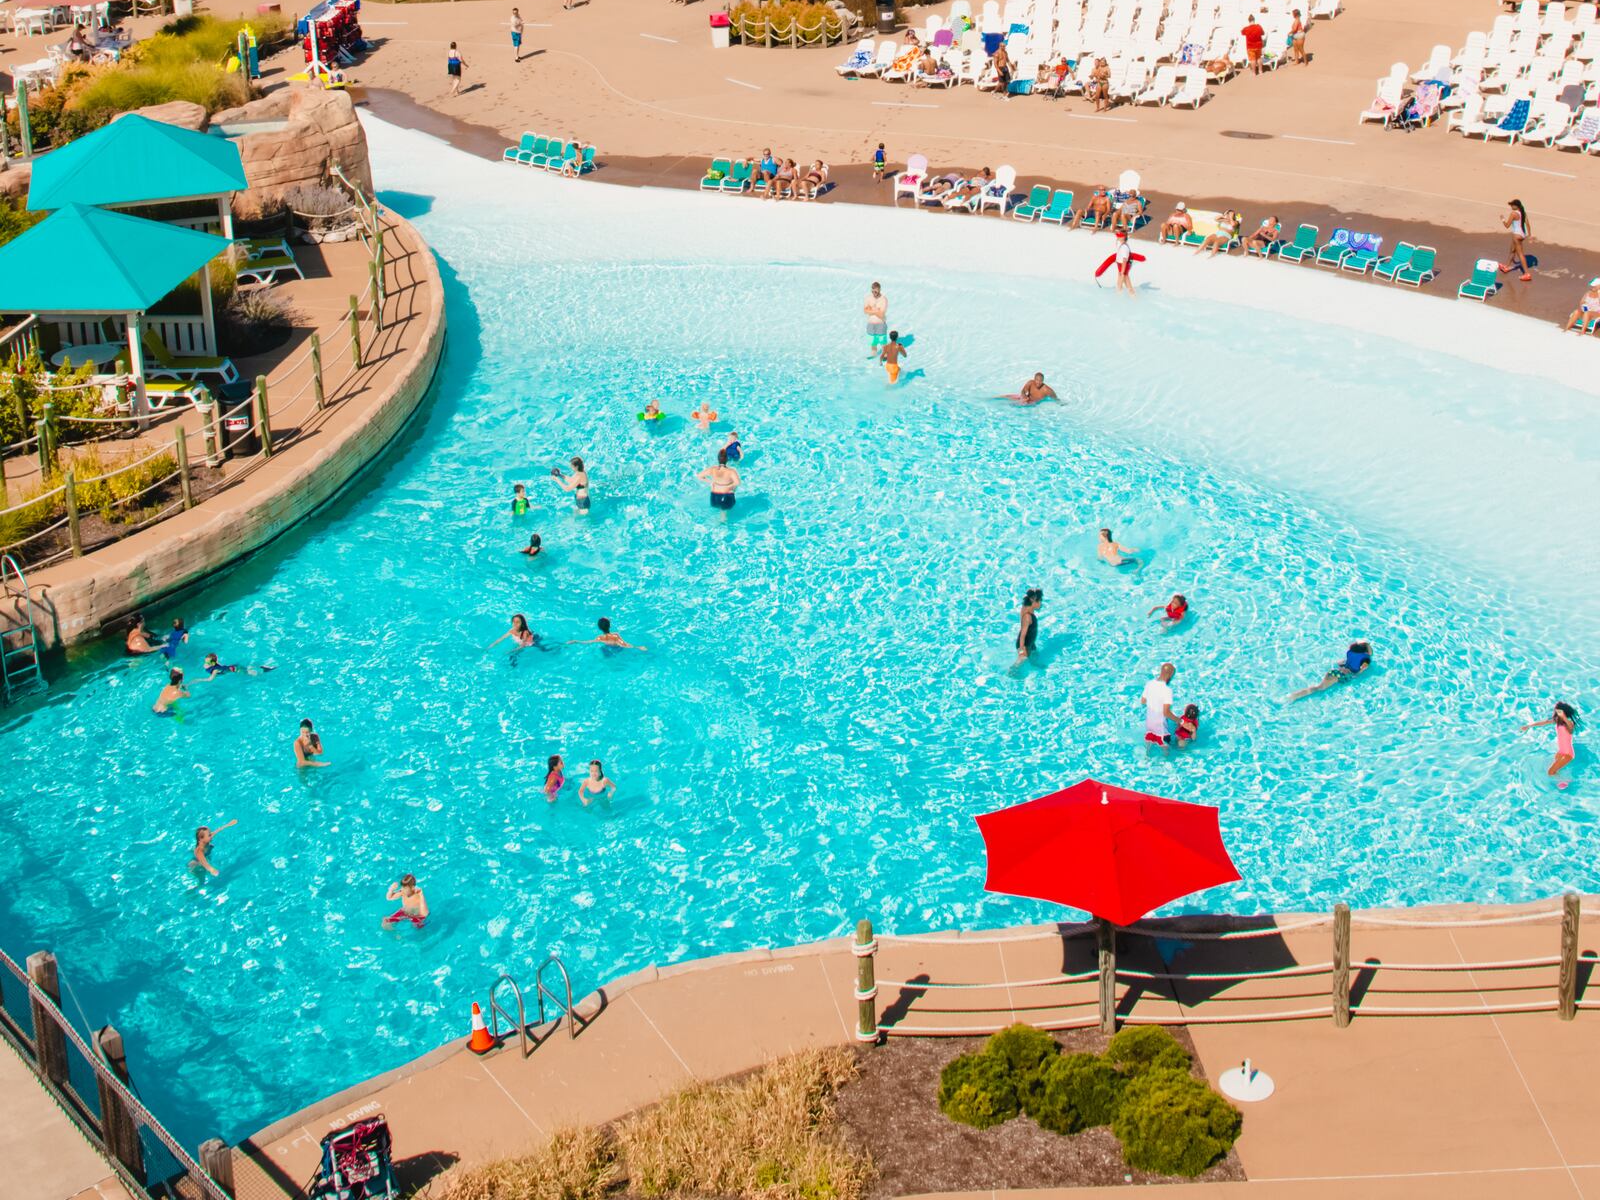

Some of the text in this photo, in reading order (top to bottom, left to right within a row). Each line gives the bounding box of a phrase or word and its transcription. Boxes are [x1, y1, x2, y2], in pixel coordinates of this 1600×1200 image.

[744, 963, 794, 977] NO DIVING
[329, 1100, 382, 1130] NO DIVING
